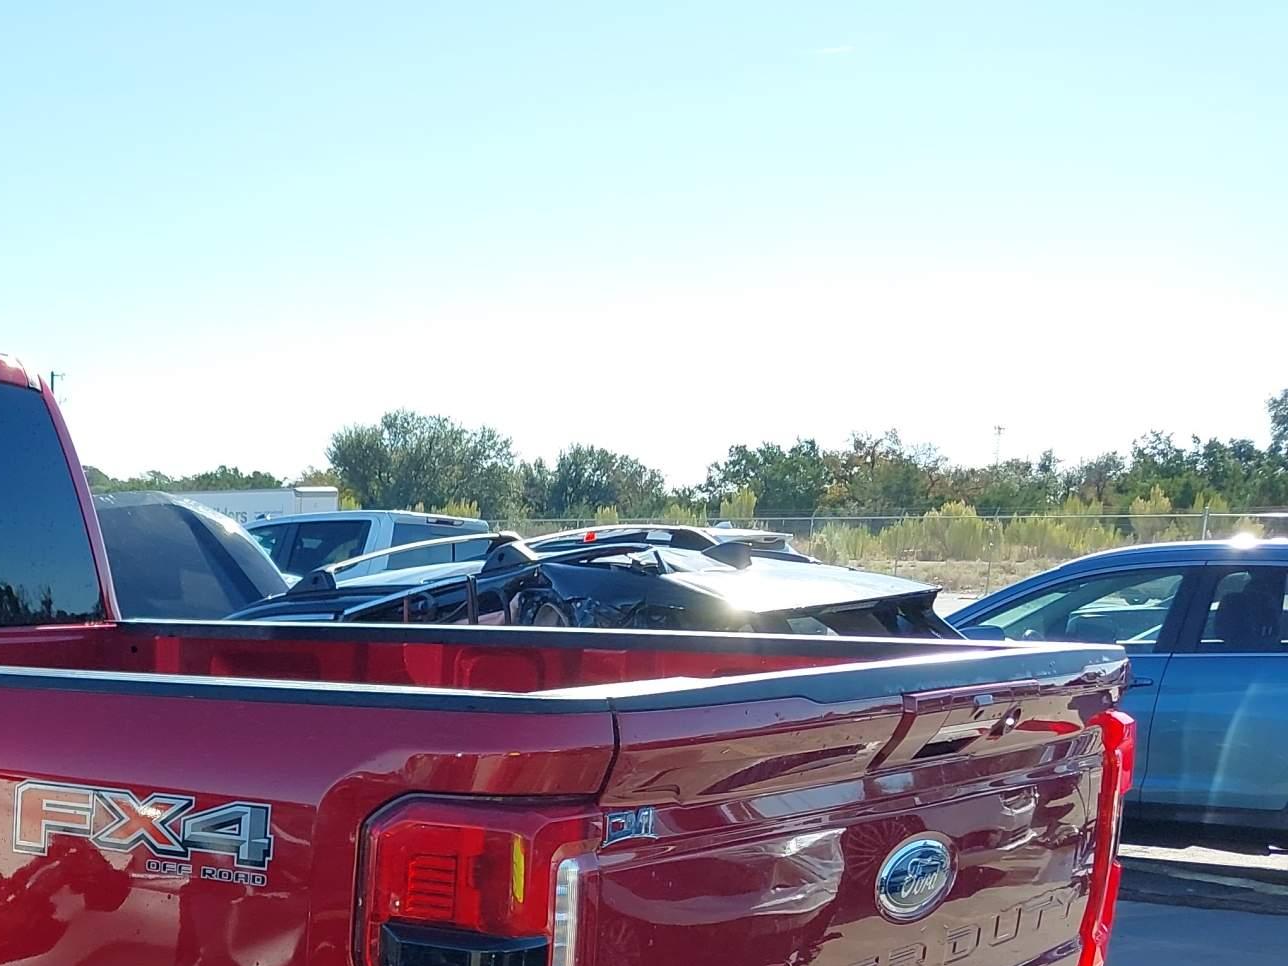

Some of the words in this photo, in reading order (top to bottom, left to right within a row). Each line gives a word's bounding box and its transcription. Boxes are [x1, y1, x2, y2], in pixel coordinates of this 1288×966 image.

[13, 780, 273, 870] FX4
[145, 859, 193, 876] OFF
[200, 867, 268, 887] ROAD
[900, 856, 946, 899] Ford
[943, 883, 1081, 966] DUTY
